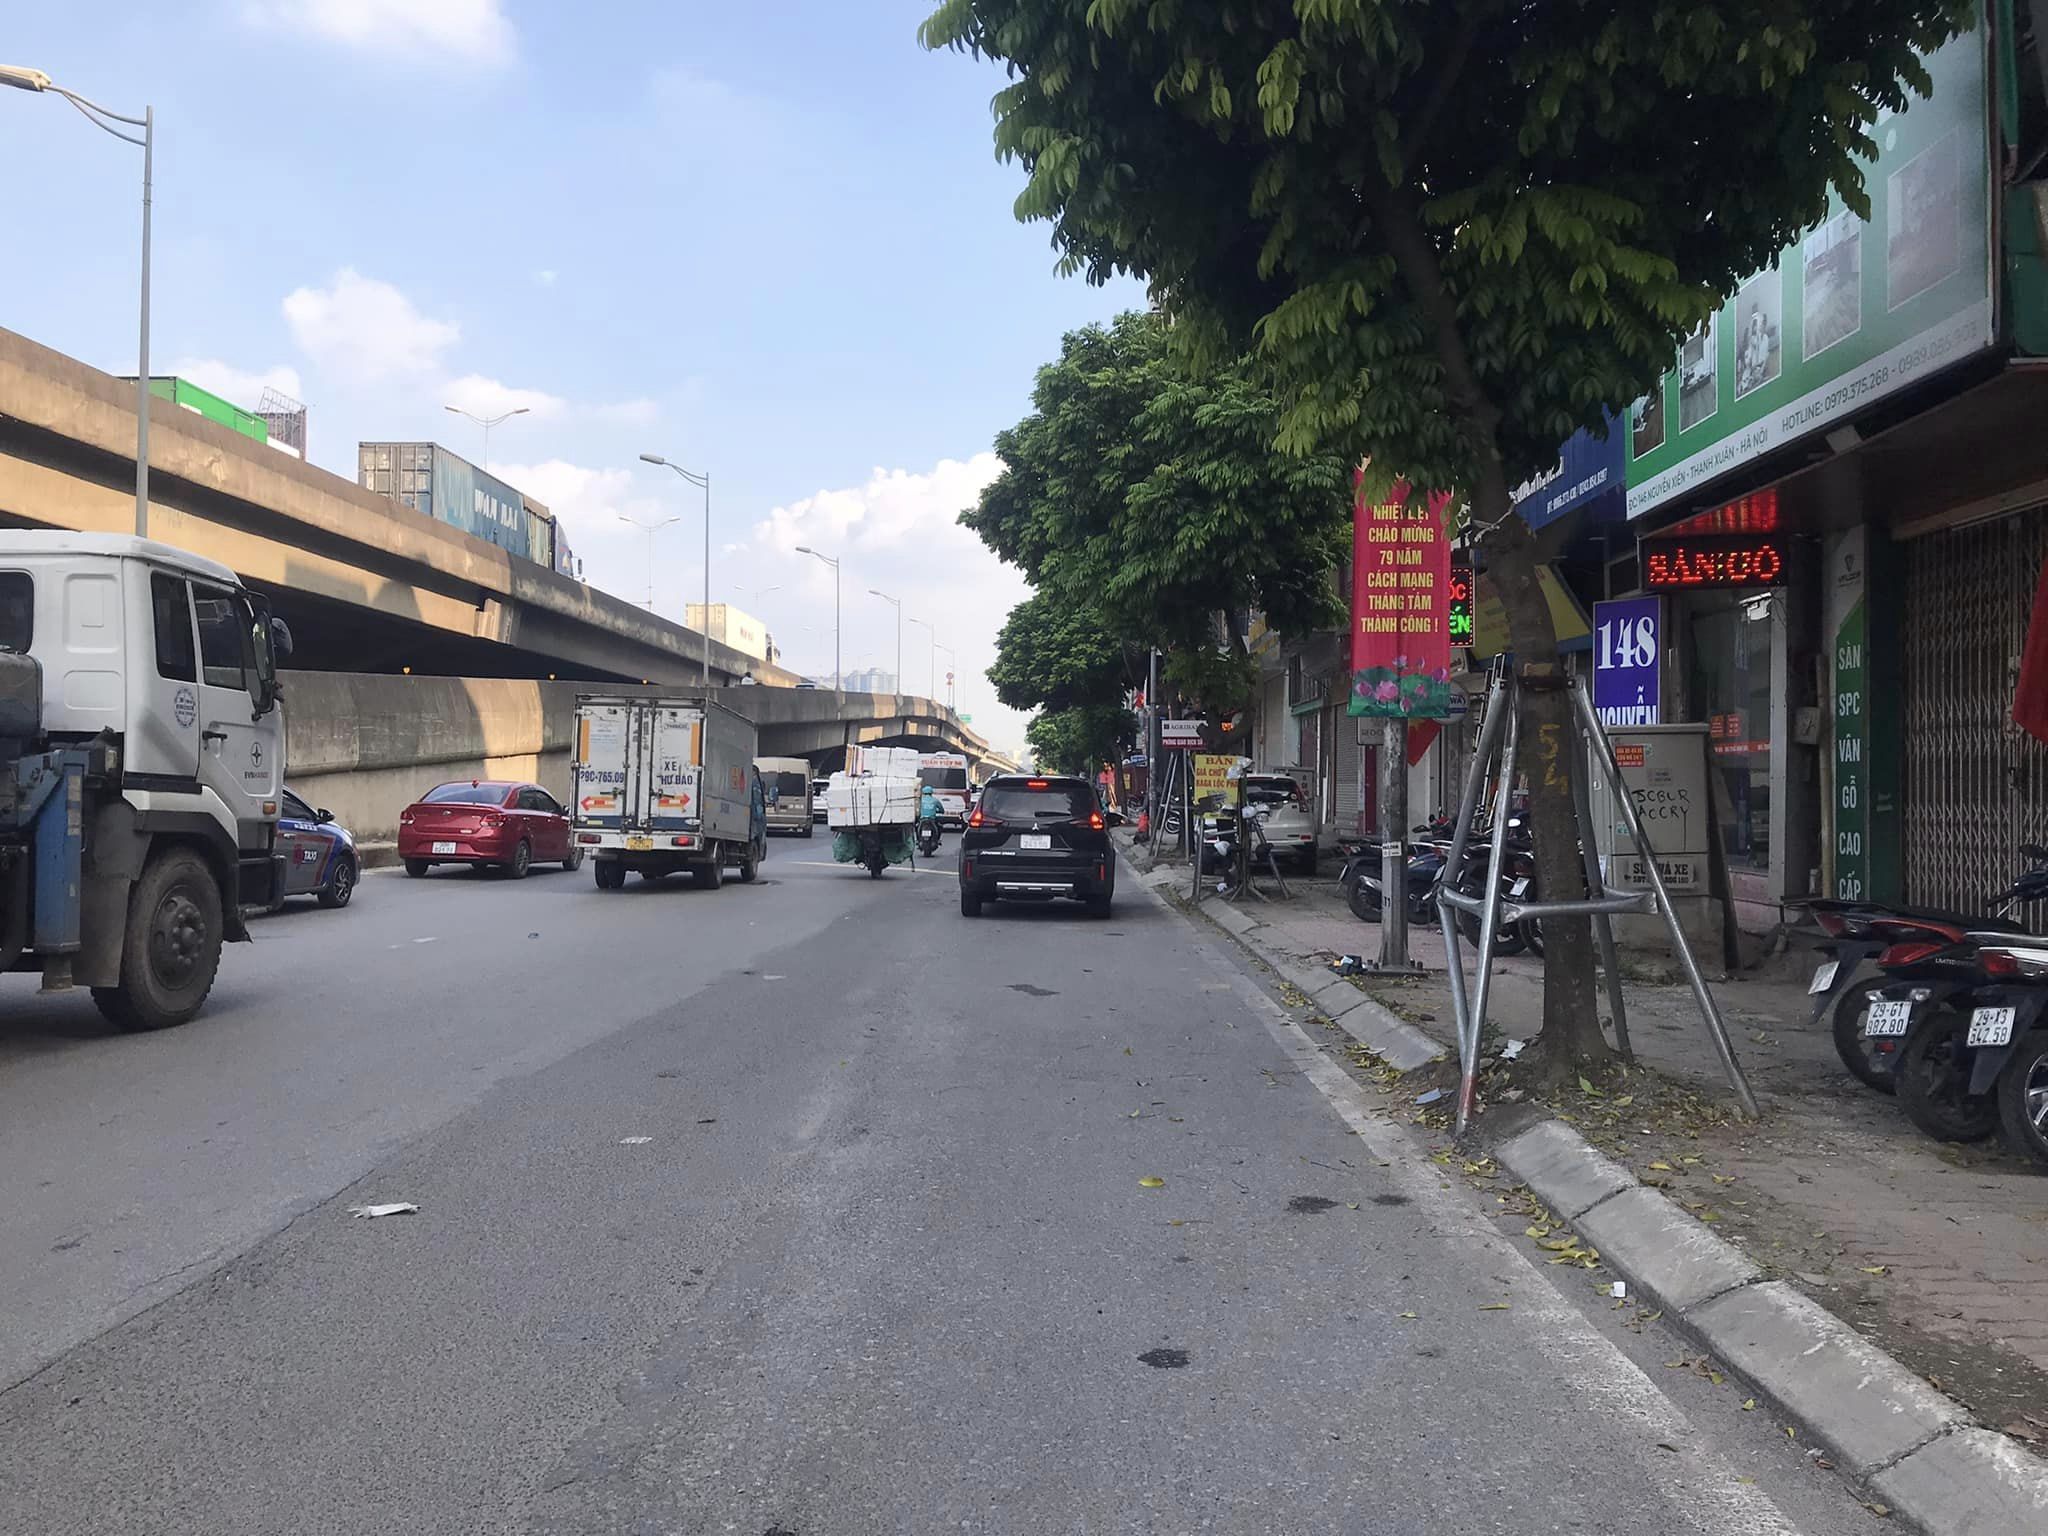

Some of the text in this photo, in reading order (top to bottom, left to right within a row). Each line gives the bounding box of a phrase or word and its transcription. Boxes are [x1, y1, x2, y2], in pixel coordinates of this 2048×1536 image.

[1782, 402, 1823, 433] HOTLINE:
[1690, 459, 1713, 479] THANH
[1713, 446, 1735, 467] XUÂN
[1740, 432, 1752, 453] HÀ
[1752, 427, 1768, 448] NỘI
[1369, 524, 1434, 542] CHÀO MỪNG
[1380, 546, 1422, 565] 79 NĂM
[1368, 569, 1434, 591] CÁCH MẠNG
[1368, 592, 1432, 610] THÁNG TÁM
[1361, 614, 1397, 633] THÀNH
[1400, 614, 1431, 633] CÔNG
[1598, 617, 1656, 669] 148
[1838, 641, 1861, 670] SÀN
[1839, 691, 1860, 716] SPC
[1838, 733, 1861, 762] VÂN
[664, 761, 677, 771] XE
[1842, 775, 1857, 808] GỖ
[1839, 832, 1861, 856] CAO
[1674, 864, 1689, 876] XE
[1839, 871, 1861, 901] CẤP
[1872, 1002, 1904, 1018] 29-G1
[1867, 1018, 1905, 1034] 982.80
